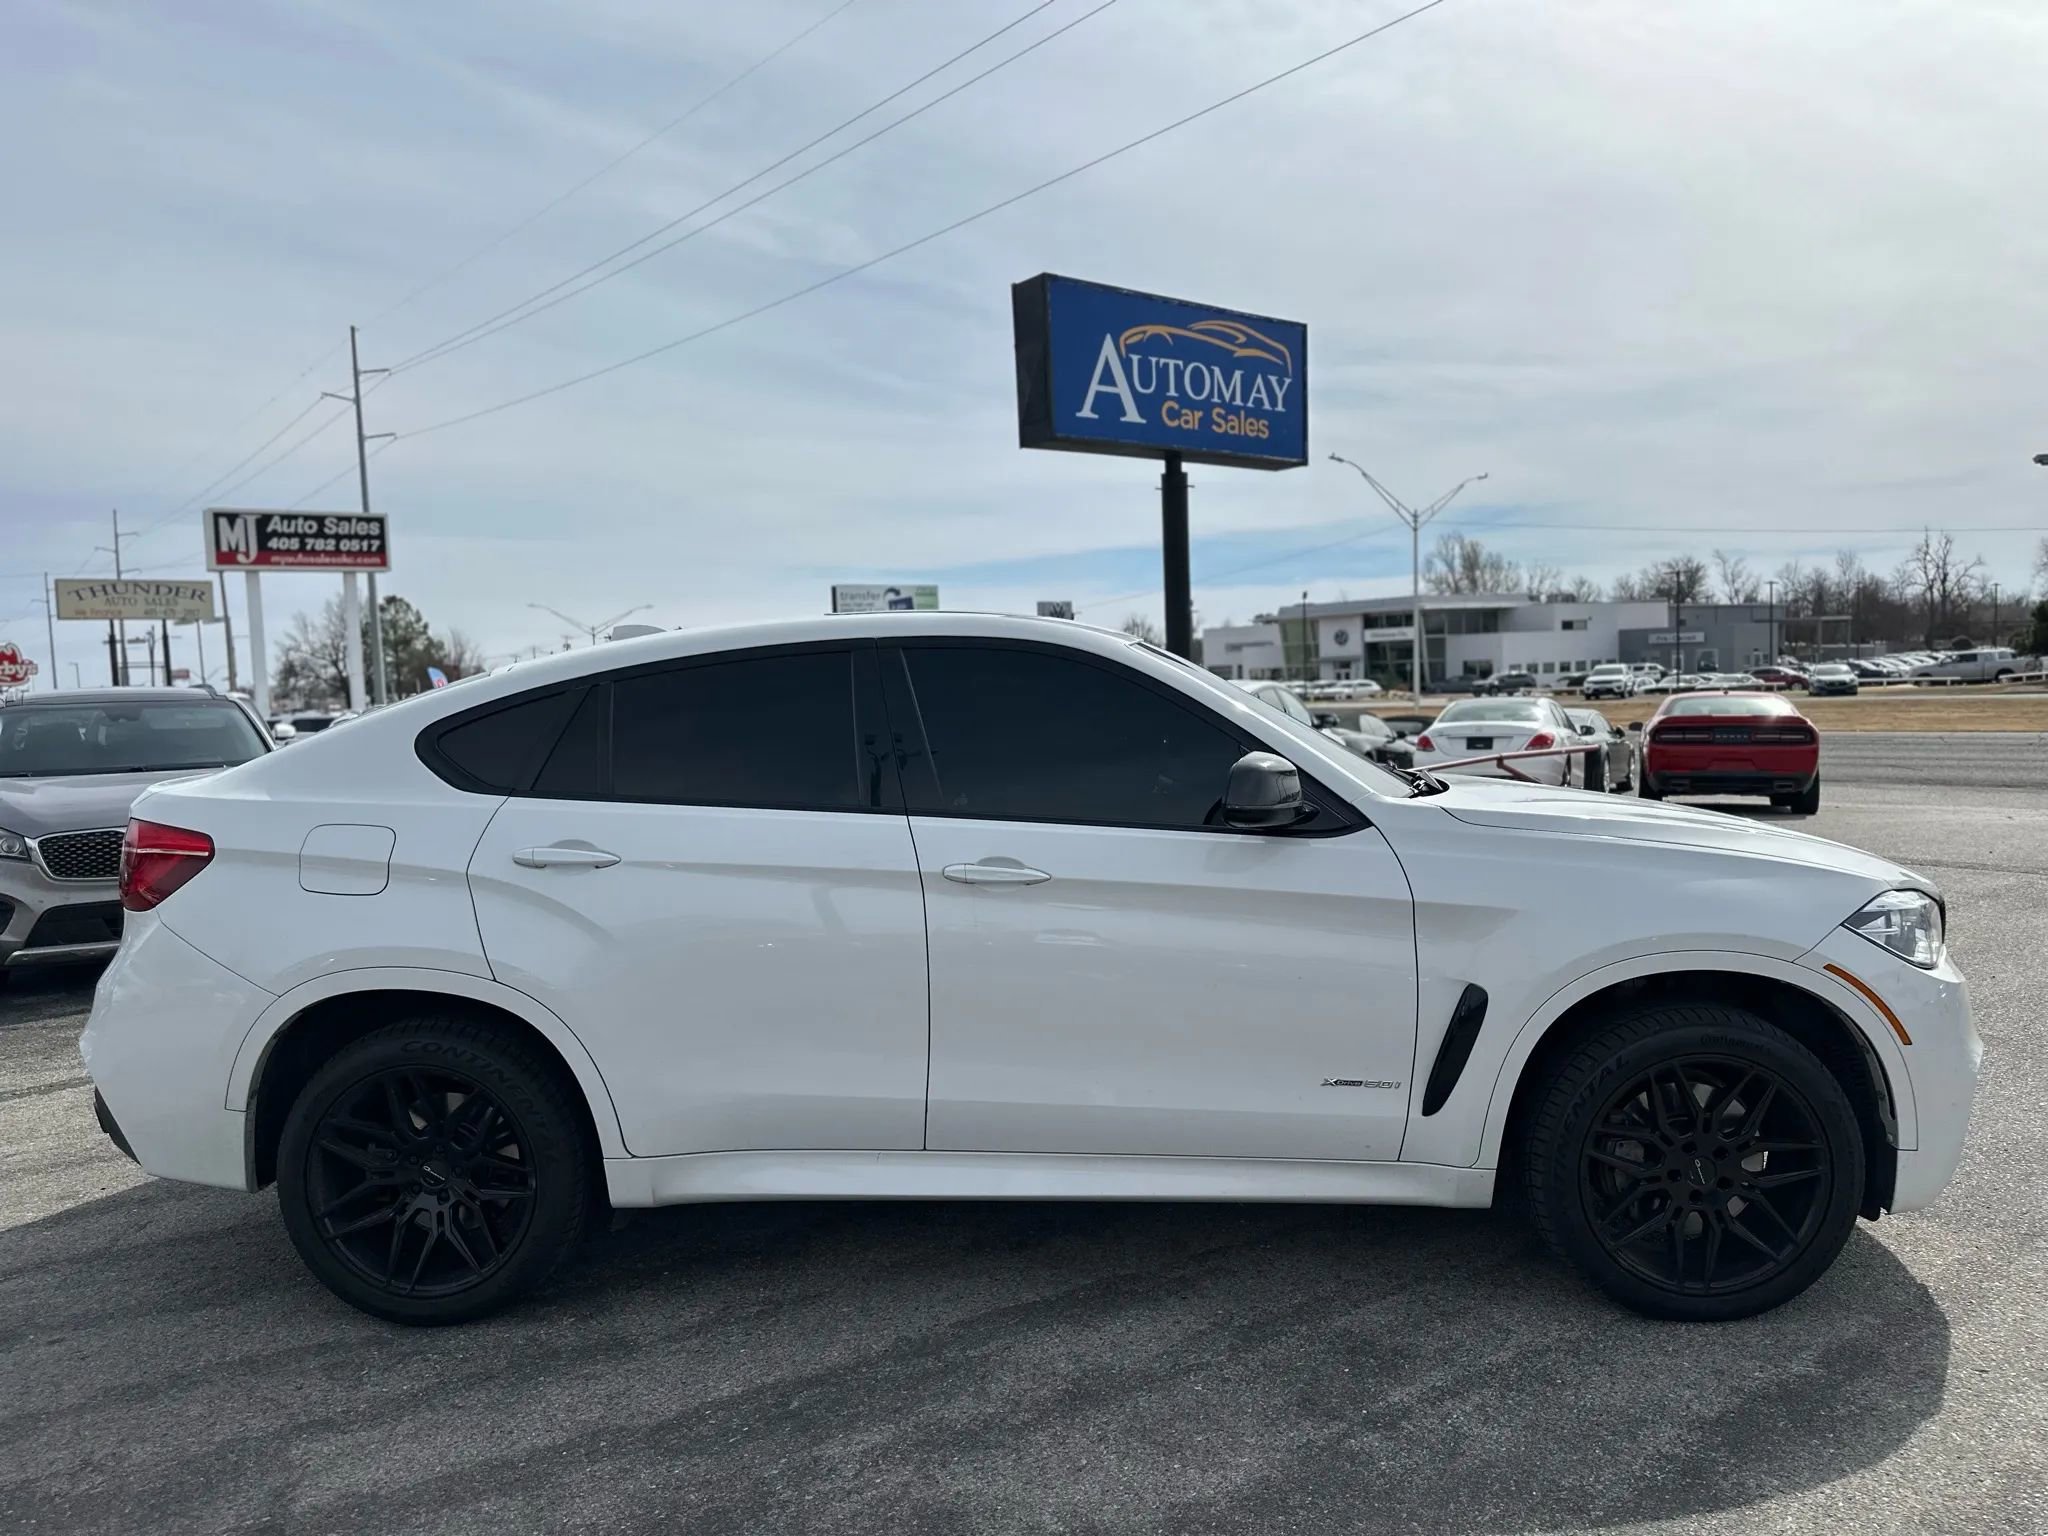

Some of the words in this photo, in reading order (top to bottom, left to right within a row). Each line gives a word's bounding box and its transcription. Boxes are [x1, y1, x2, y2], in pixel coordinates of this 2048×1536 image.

[1075, 333, 1293, 424] AUTOMAY
[1161, 400, 1203, 431] Car
[1211, 407, 1270, 439] Sales
[266, 515, 318, 534] Auto
[323, 516, 381, 535] Sales
[218, 514, 262, 564] MJ
[267, 537, 300, 550] 405
[305, 538, 336, 551] 782
[339, 539, 381, 552] 0517
[67, 582, 207, 603] THUNDER
[104, 596, 138, 607] AUTO
[145, 596, 179, 607] SALES
